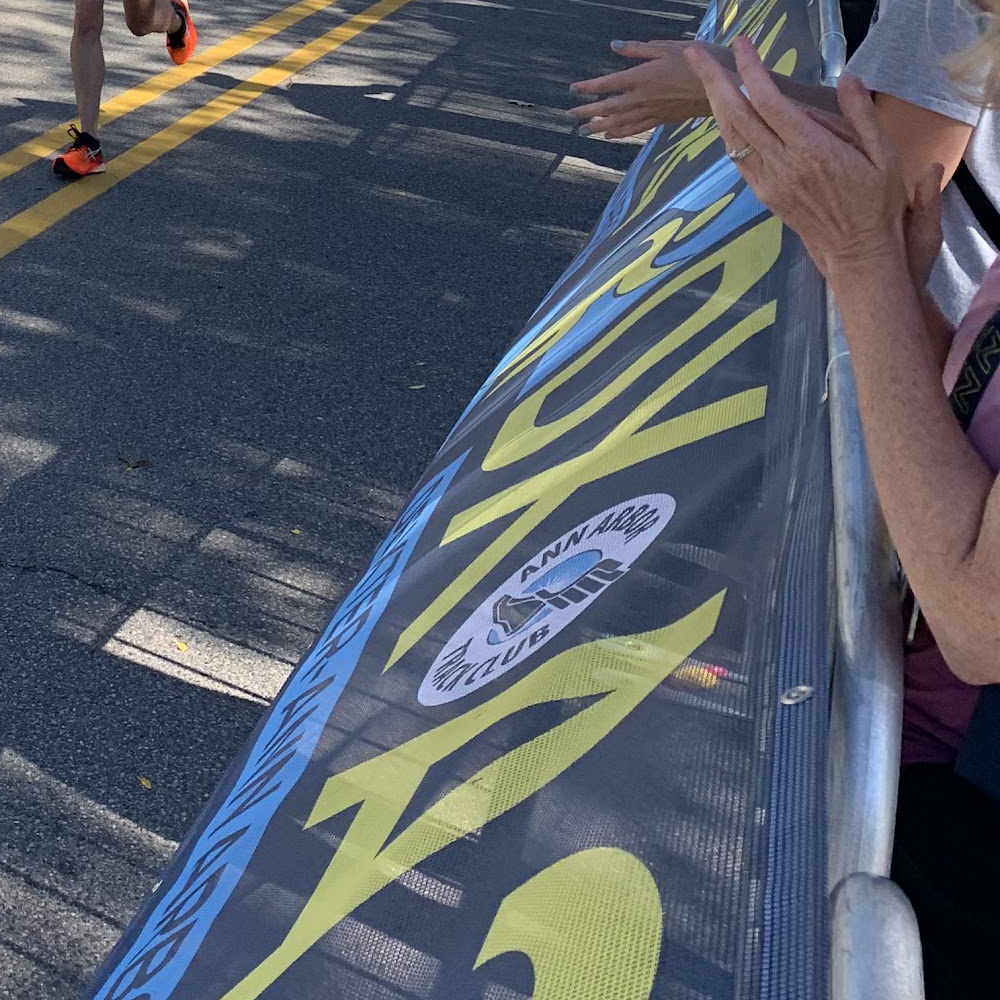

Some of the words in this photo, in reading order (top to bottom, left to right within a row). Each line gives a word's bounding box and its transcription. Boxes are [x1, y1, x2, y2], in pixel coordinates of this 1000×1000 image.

[520, 525, 590, 584] ANN
[586, 503, 661, 546] ARBOR
[464, 624, 550, 686] CLUB
[104, 823, 252, 1000] ARB
